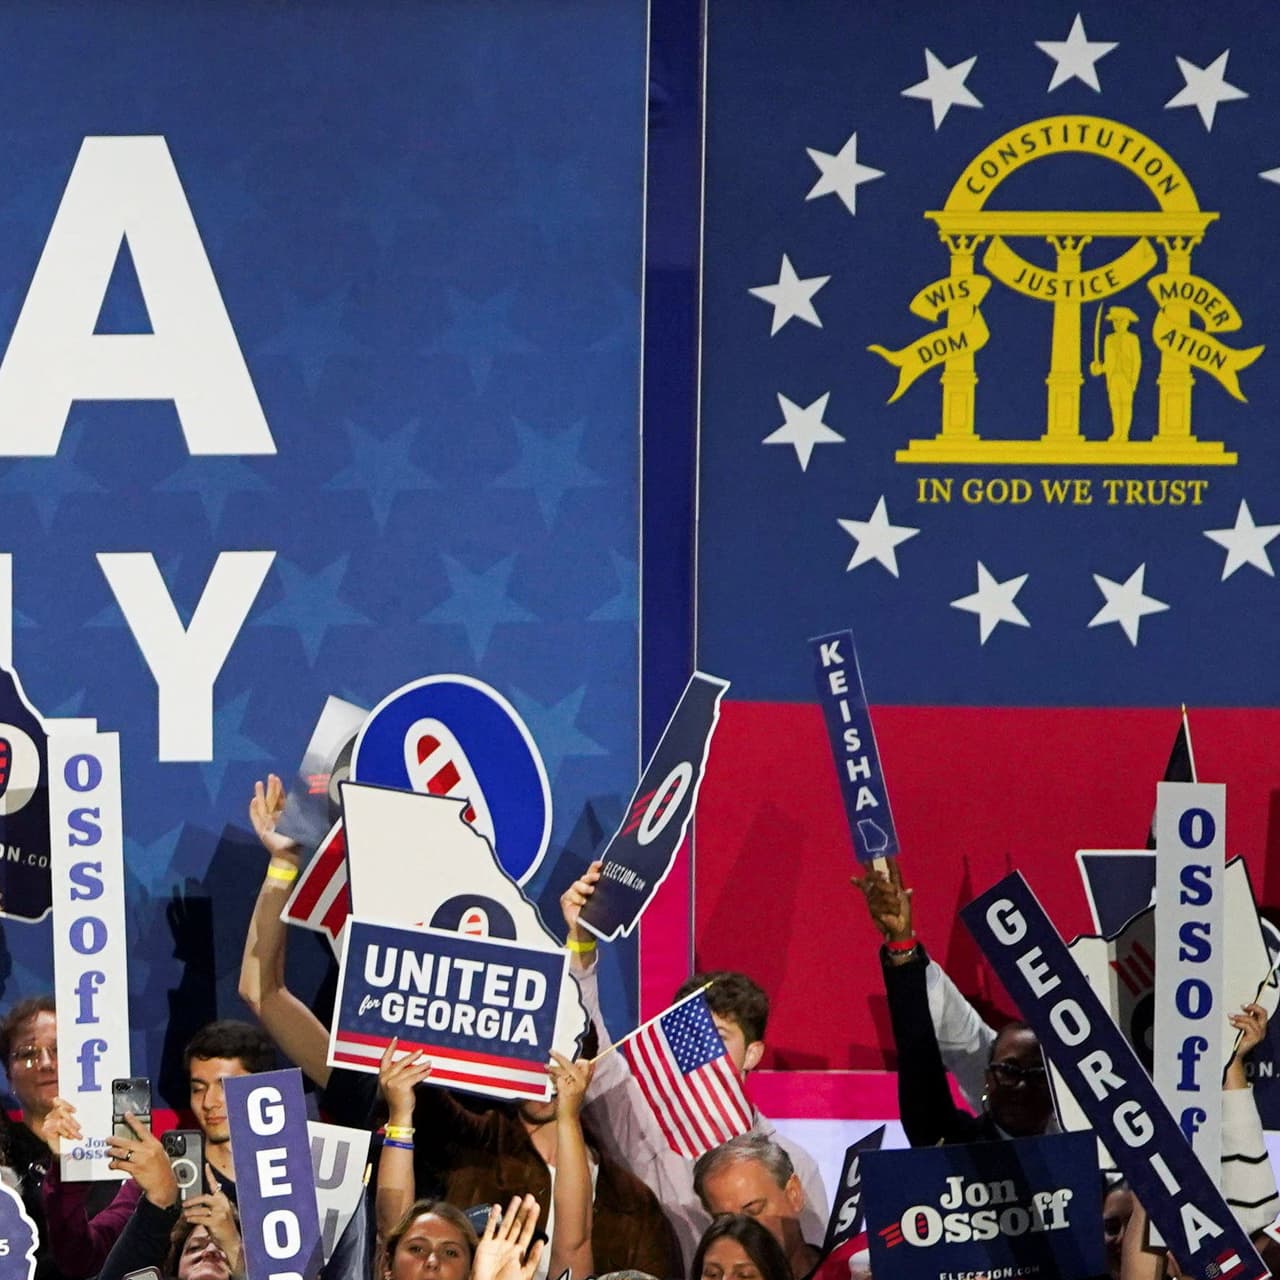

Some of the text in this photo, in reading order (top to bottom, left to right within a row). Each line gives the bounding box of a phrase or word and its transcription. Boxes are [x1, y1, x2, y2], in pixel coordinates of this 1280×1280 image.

[965, 125, 1181, 196] CONSTITUTION
[924, 282, 971, 309] WIS
[1014, 268, 1120, 299] JUSTICE
[1159, 282, 1231, 329] MODER
[917, 332, 969, 364] DOM
[1160, 331, 1228, 371] ATION
[916, 478, 1208, 505] IN GOD WE TRUST
[819, 640, 878, 811] KEISHA
[364, 944, 547, 1011] UNITED
[381, 993, 539, 1046] GEORGIA
[985, 898, 1223, 1253] GEORGIA
[940, 1176, 1018, 1209] Jon
[900, 1188, 1073, 1247] Ossoff
